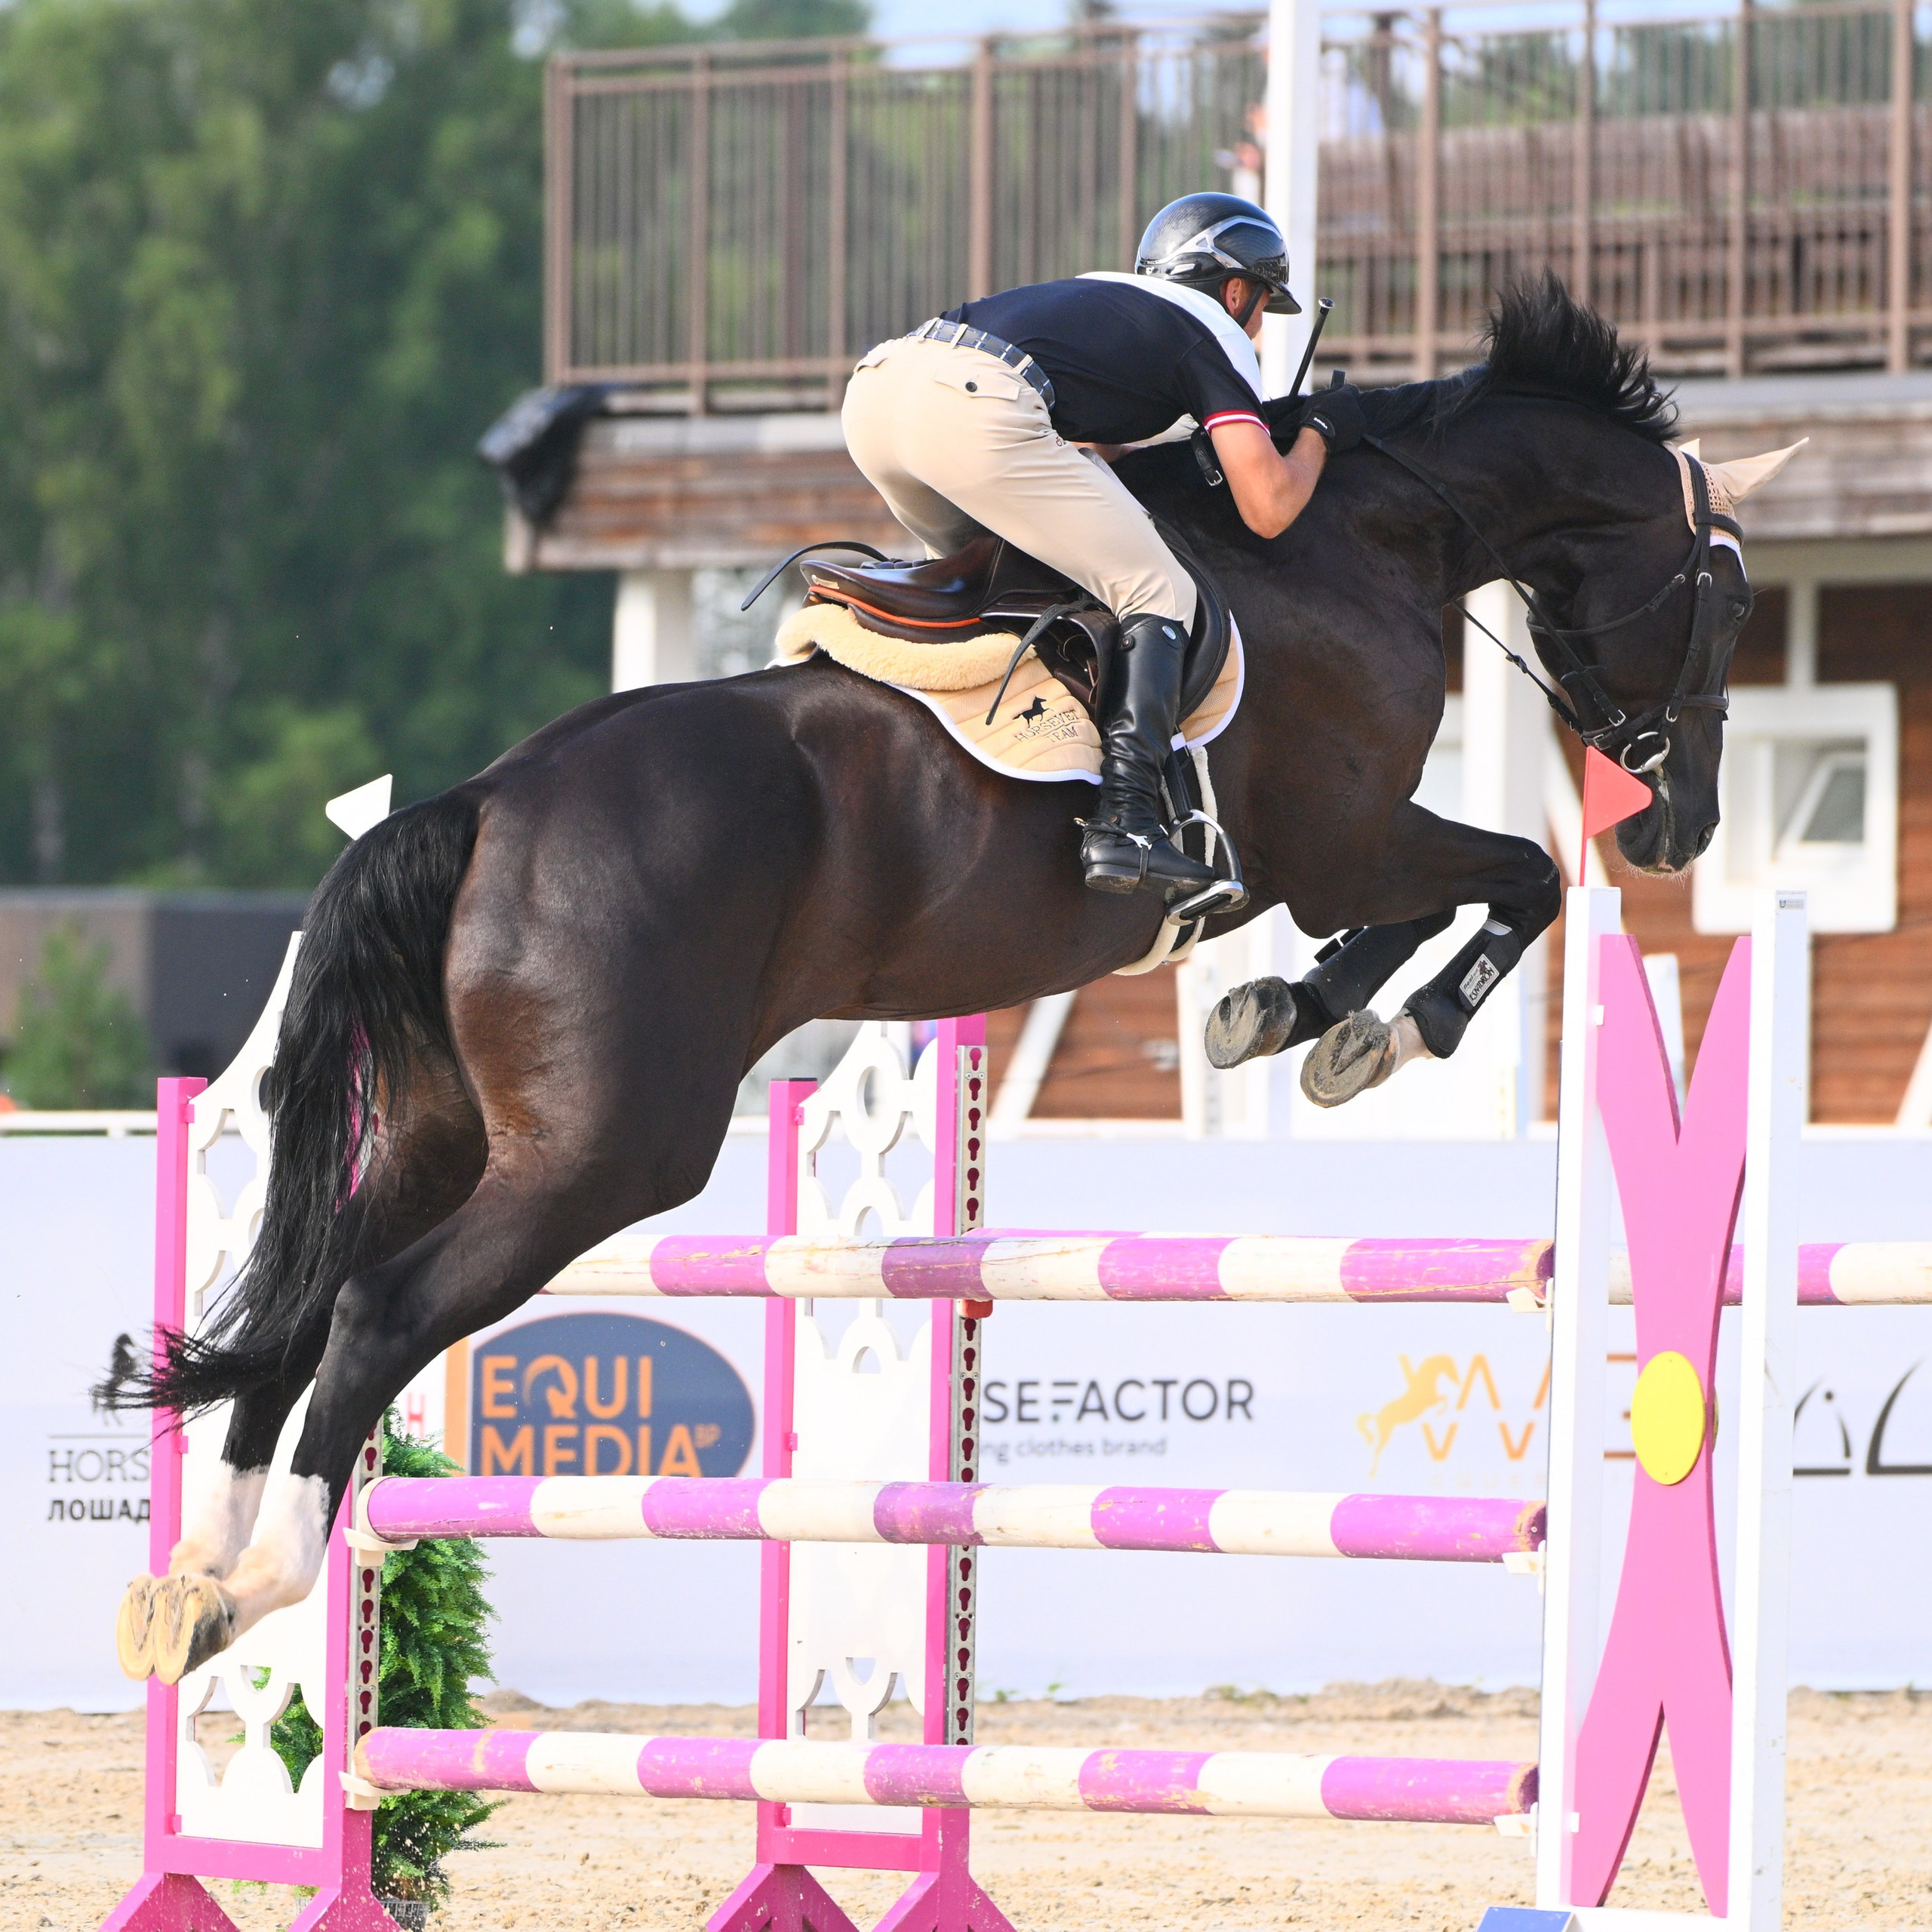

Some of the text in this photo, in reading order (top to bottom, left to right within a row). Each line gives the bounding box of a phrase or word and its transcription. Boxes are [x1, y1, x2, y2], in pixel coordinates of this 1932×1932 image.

[1014, 709, 1078, 741] HORSEVET
[1045, 726, 1078, 743] TEAM
[481, 1355, 652, 1419] EQUI
[481, 1423, 703, 1477] MEDIA
[1017, 1435, 1094, 1457] clothes
[1101, 1435, 1167, 1457] brand
